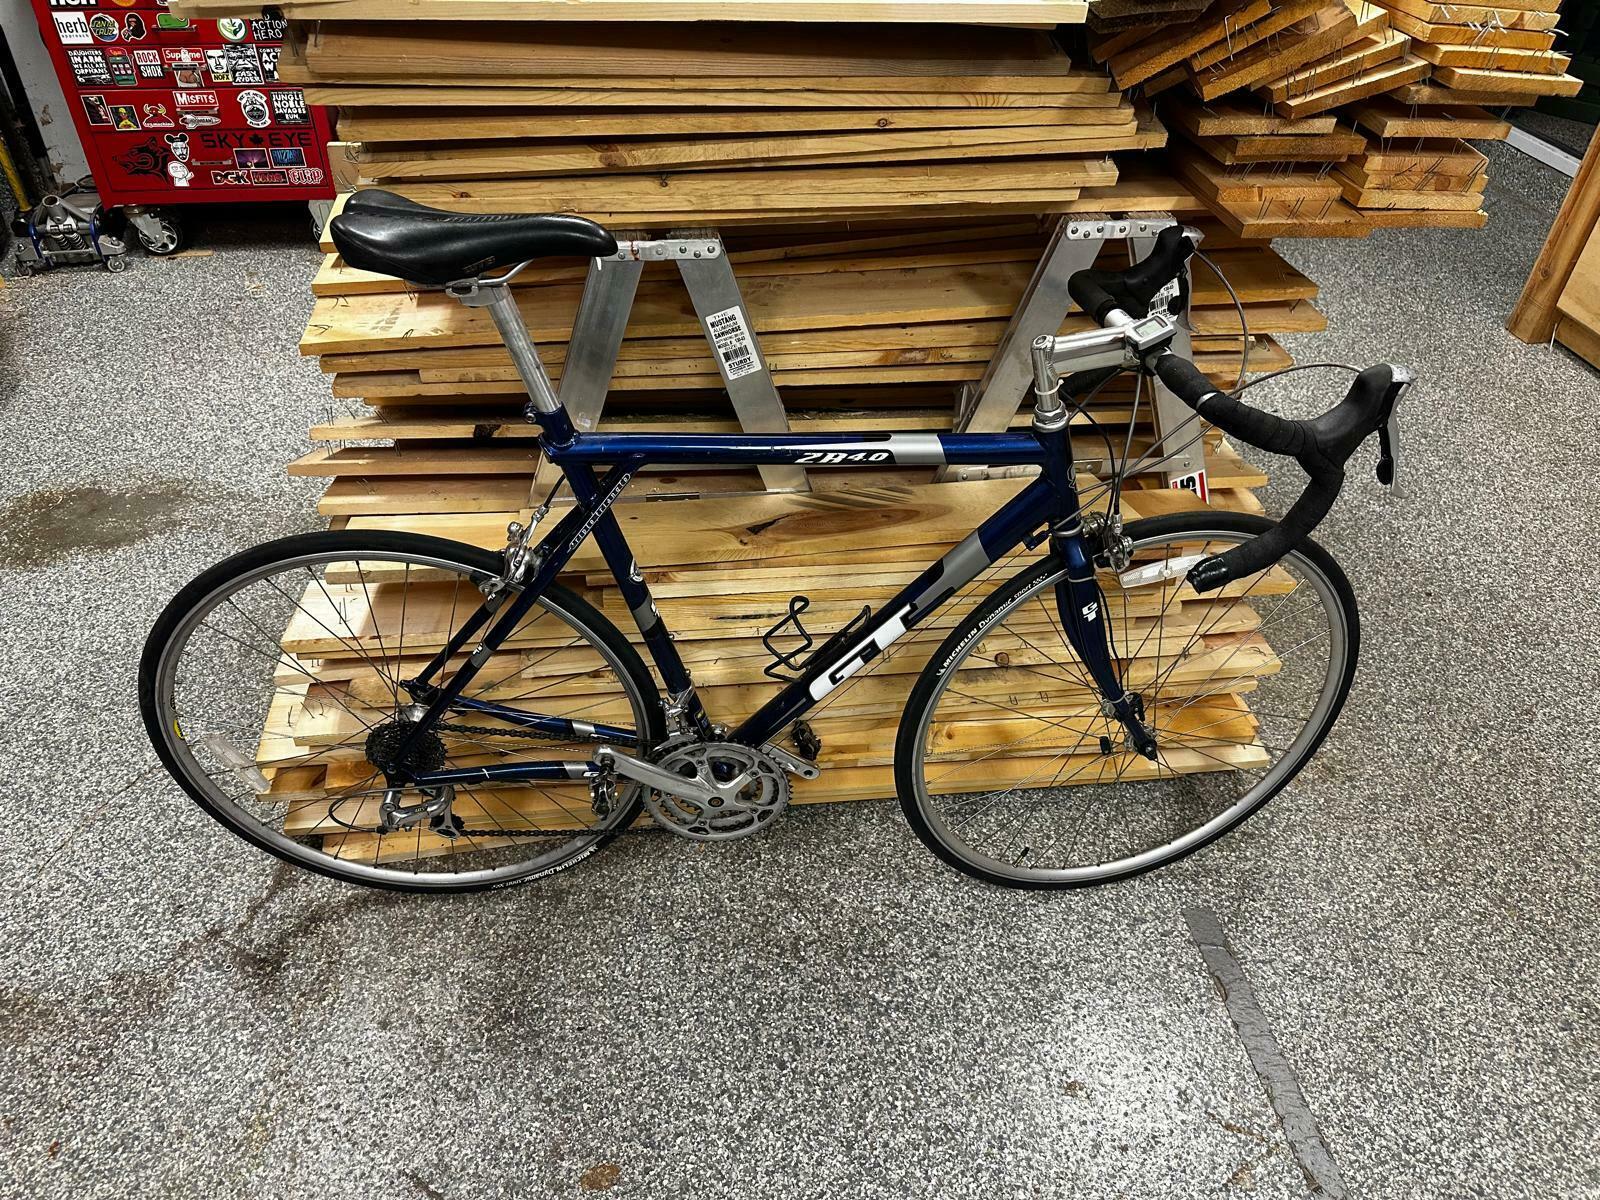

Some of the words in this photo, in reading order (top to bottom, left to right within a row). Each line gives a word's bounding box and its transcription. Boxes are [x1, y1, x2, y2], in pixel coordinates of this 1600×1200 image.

[55, 17, 89, 34] herb
[251, 19, 288, 30] ACTION
[253, 30, 283, 40] HERO
[135, 51, 158, 63] ROCK
[140, 65, 164, 77] SHOX
[213, 73, 230, 81] NOFX
[272, 93, 304, 101] JUNGLE
[273, 100, 306, 108] NOBLE
[201, 132, 246, 148] SKY
[268, 132, 313, 147] EYE
[709, 313, 737, 329] MUSTANG
[713, 325, 742, 340] SAWHORSE
[728, 357, 751, 369] STURDY
[1081, 601, 1099, 622] GT
[808, 602, 912, 701] GT
[943, 628, 978, 668] MICHELIN
[556, 850, 591, 872] MICHELIN
